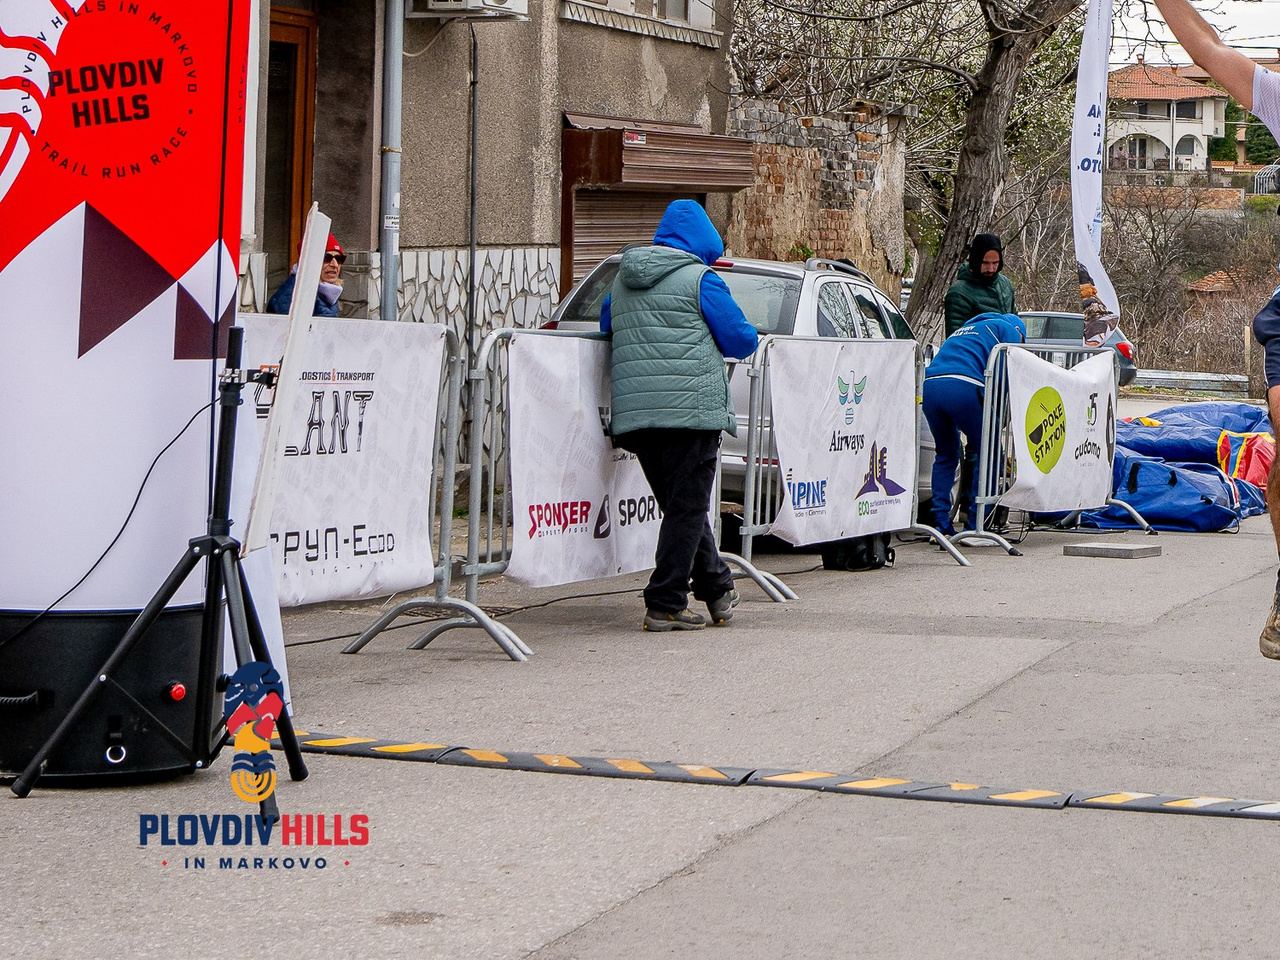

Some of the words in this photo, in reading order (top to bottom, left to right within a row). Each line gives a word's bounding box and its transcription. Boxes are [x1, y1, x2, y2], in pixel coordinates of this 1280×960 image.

[20, 31, 48, 114] PLOVDIV
[51, 0, 107, 29] HILLS
[119, 0, 139, 15] IN
[148, 11, 197, 93] MARKOVO
[47, 57, 164, 97] PLOVDIV
[71, 93, 150, 128] HILLS
[40, 141, 88, 177] TRAIL
[102, 163, 141, 179] RUN
[150, 126, 188, 166] RACE
[337, 372, 376, 381] TRANSPORT
[1042, 403, 1063, 433] POKE
[829, 430, 865, 456] Airways
[528, 501, 591, 540] SPONSER
